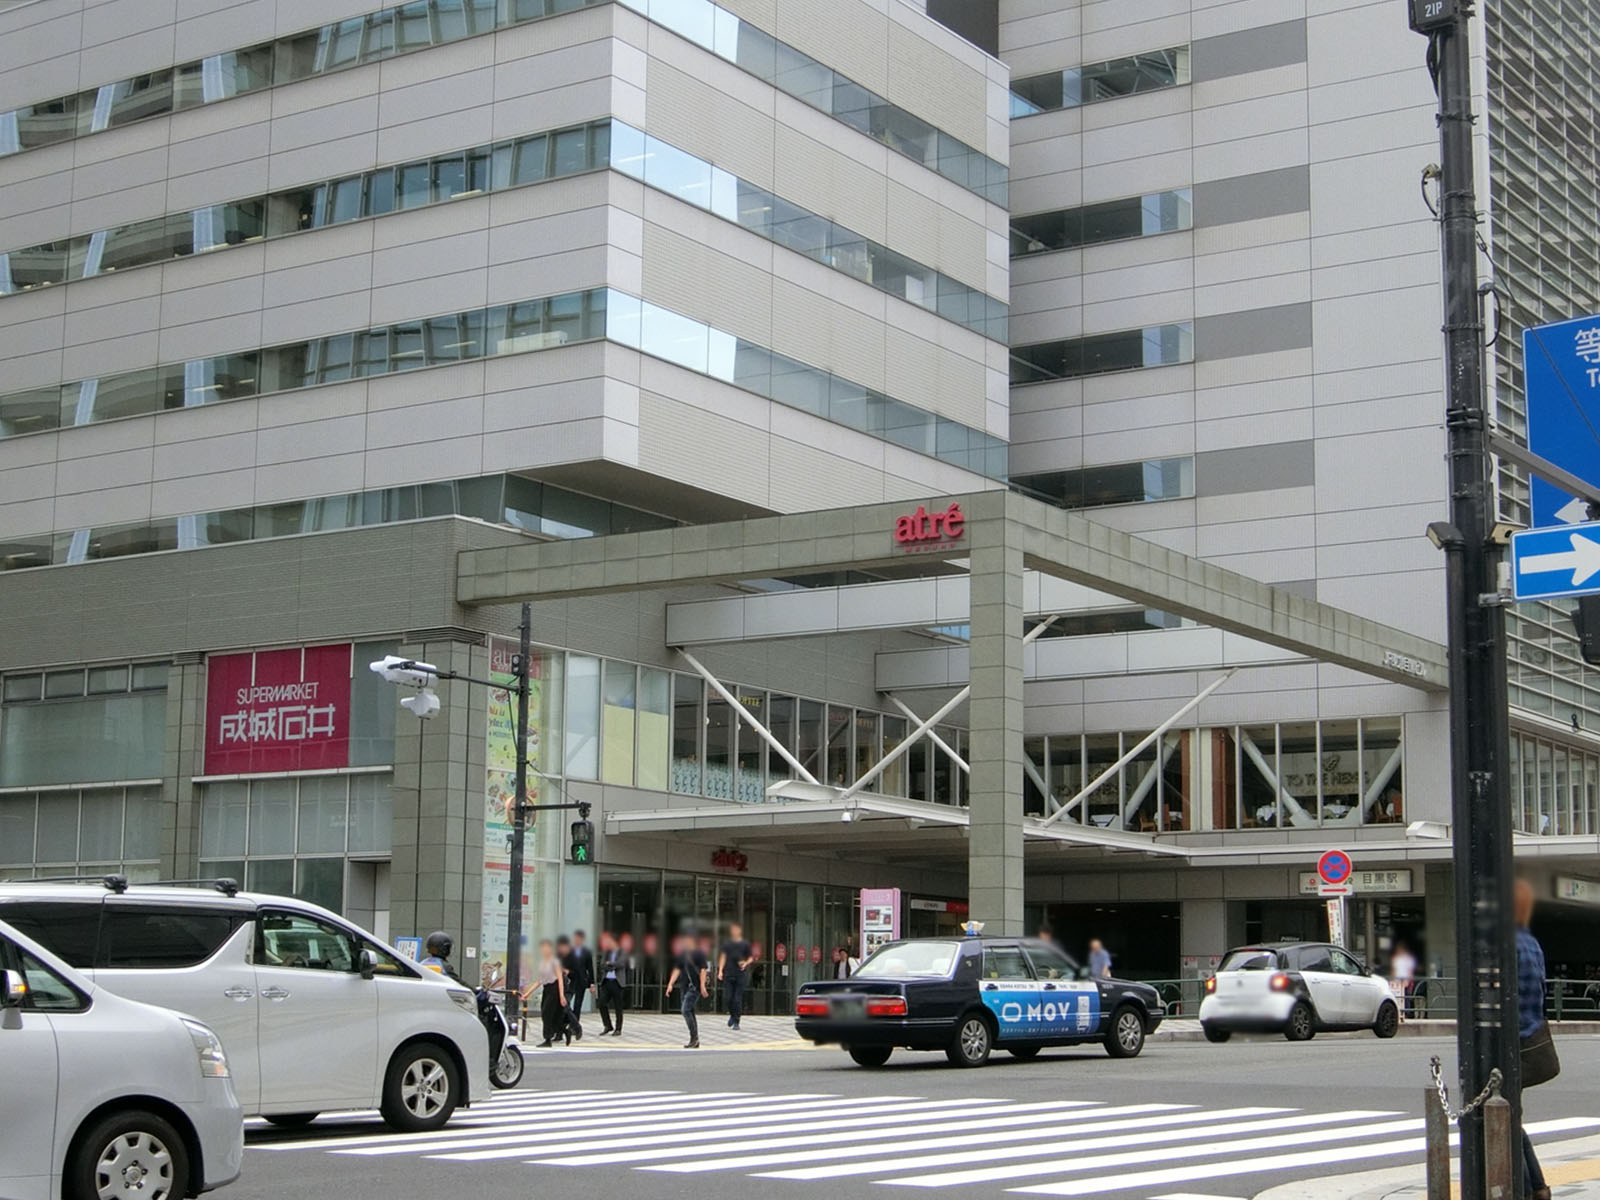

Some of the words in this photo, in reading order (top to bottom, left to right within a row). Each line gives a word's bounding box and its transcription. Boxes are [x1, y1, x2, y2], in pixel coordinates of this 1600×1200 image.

[1586, 368, 1600, 388] T
[895, 502, 965, 542] atré
[236, 682, 320, 705] SUPERMARKET
[219, 703, 336, 745] 成城石井
[1363, 872, 1398, 884] 目黒駅
[1027, 1002, 1070, 1022] MOV
